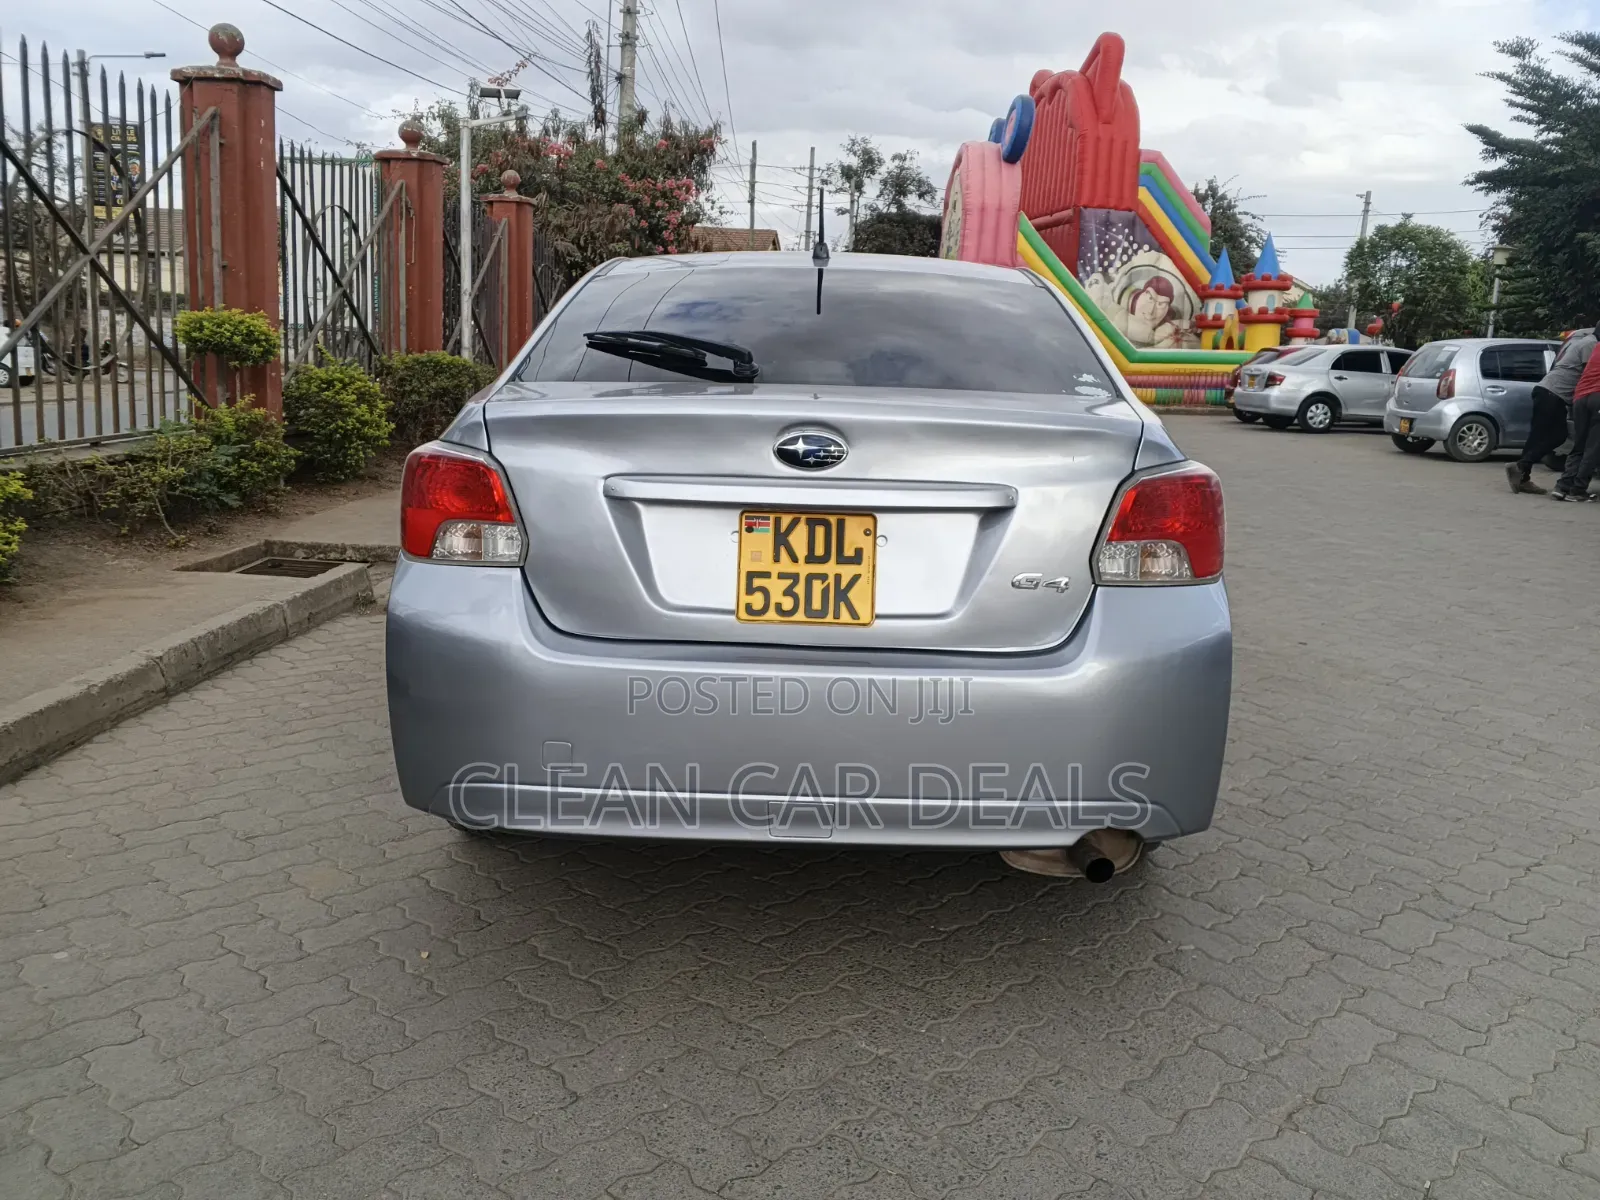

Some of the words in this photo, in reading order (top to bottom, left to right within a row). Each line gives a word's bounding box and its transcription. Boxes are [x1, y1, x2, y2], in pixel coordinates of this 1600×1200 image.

[773, 516, 864, 565] KDL
[745, 571, 862, 620] 530K
[1011, 573, 1071, 593] G4
